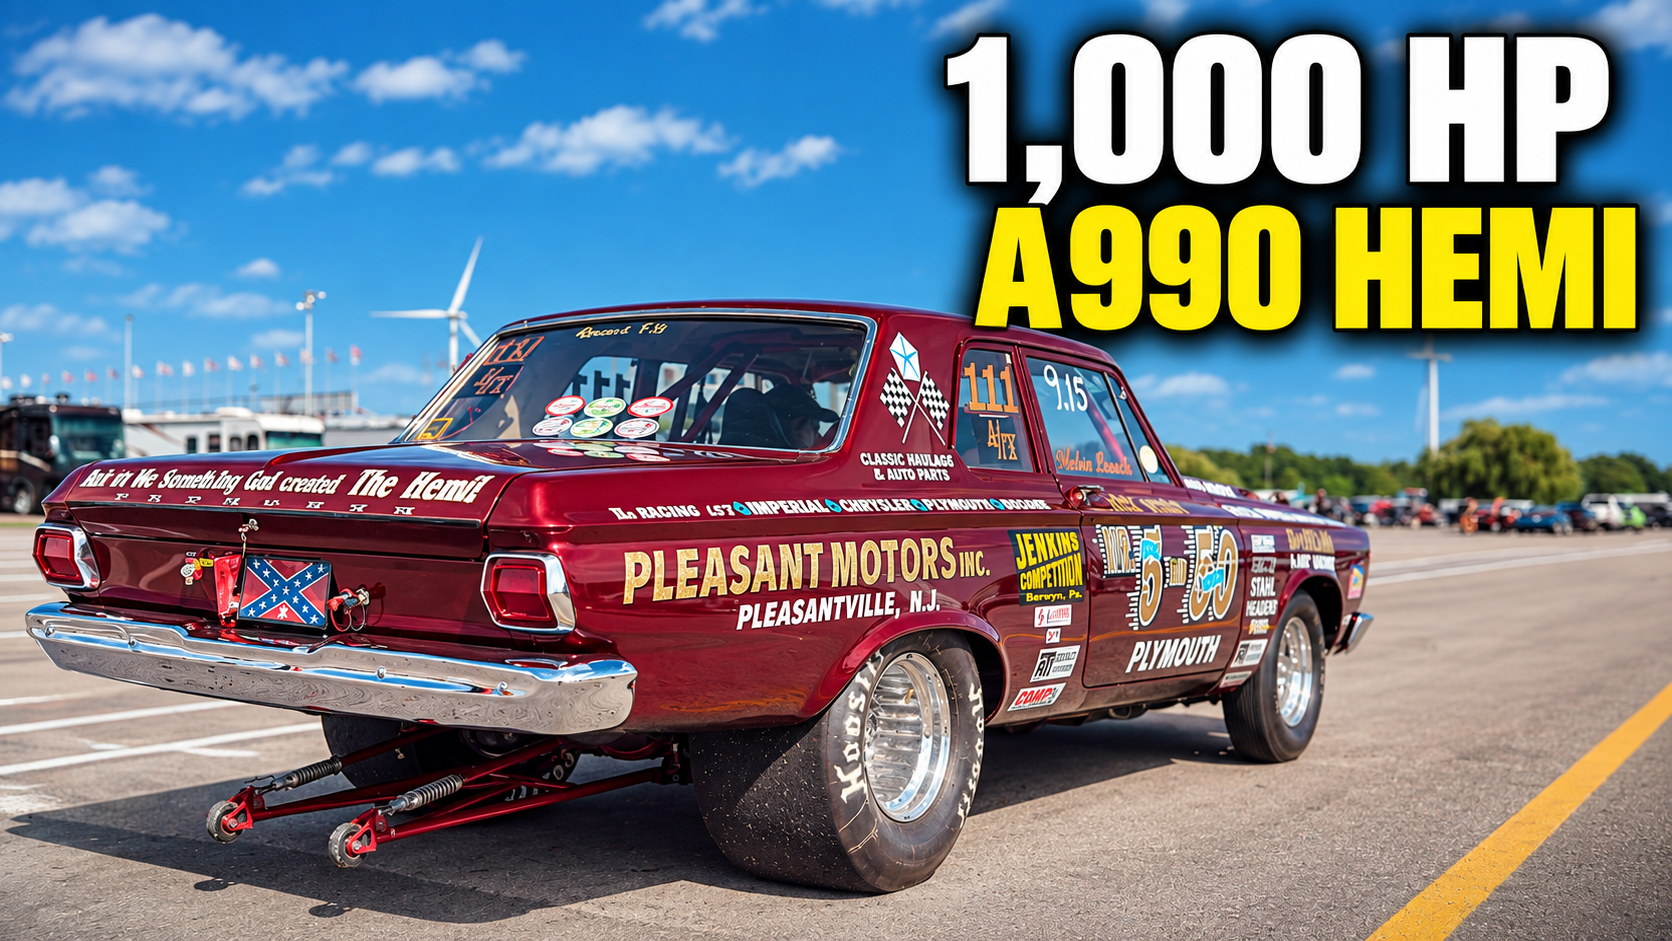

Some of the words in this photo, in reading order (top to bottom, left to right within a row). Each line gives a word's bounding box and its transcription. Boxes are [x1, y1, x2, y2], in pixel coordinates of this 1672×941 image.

[964, 362, 1019, 413] 111
[1043, 364, 1088, 412] 9.15
[860, 452, 905, 466] CLASSIC
[873, 468, 886, 480] &
[887, 468, 916, 481] AUTO
[916, 468, 951, 481] PARTS
[280, 473, 347, 495] created
[347, 468, 399, 498] The
[635, 505, 700, 520] RACING
[745, 499, 831, 516] IMPERIAL
[839, 499, 917, 512] CHRYSLER
[1015, 531, 1080, 570] JENKINS
[622, 542, 824, 605] PLEASANT
[830, 536, 957, 588] MOTORS
[959, 550, 991, 578] INC.
[1020, 552, 1083, 591] COMPETITION
[1250, 576, 1276, 597] STAHL
[736, 591, 901, 630] PLEASANTVILLE,
[909, 589, 940, 613] N.J.
[1126, 634, 1222, 673] PLYMOUTH
